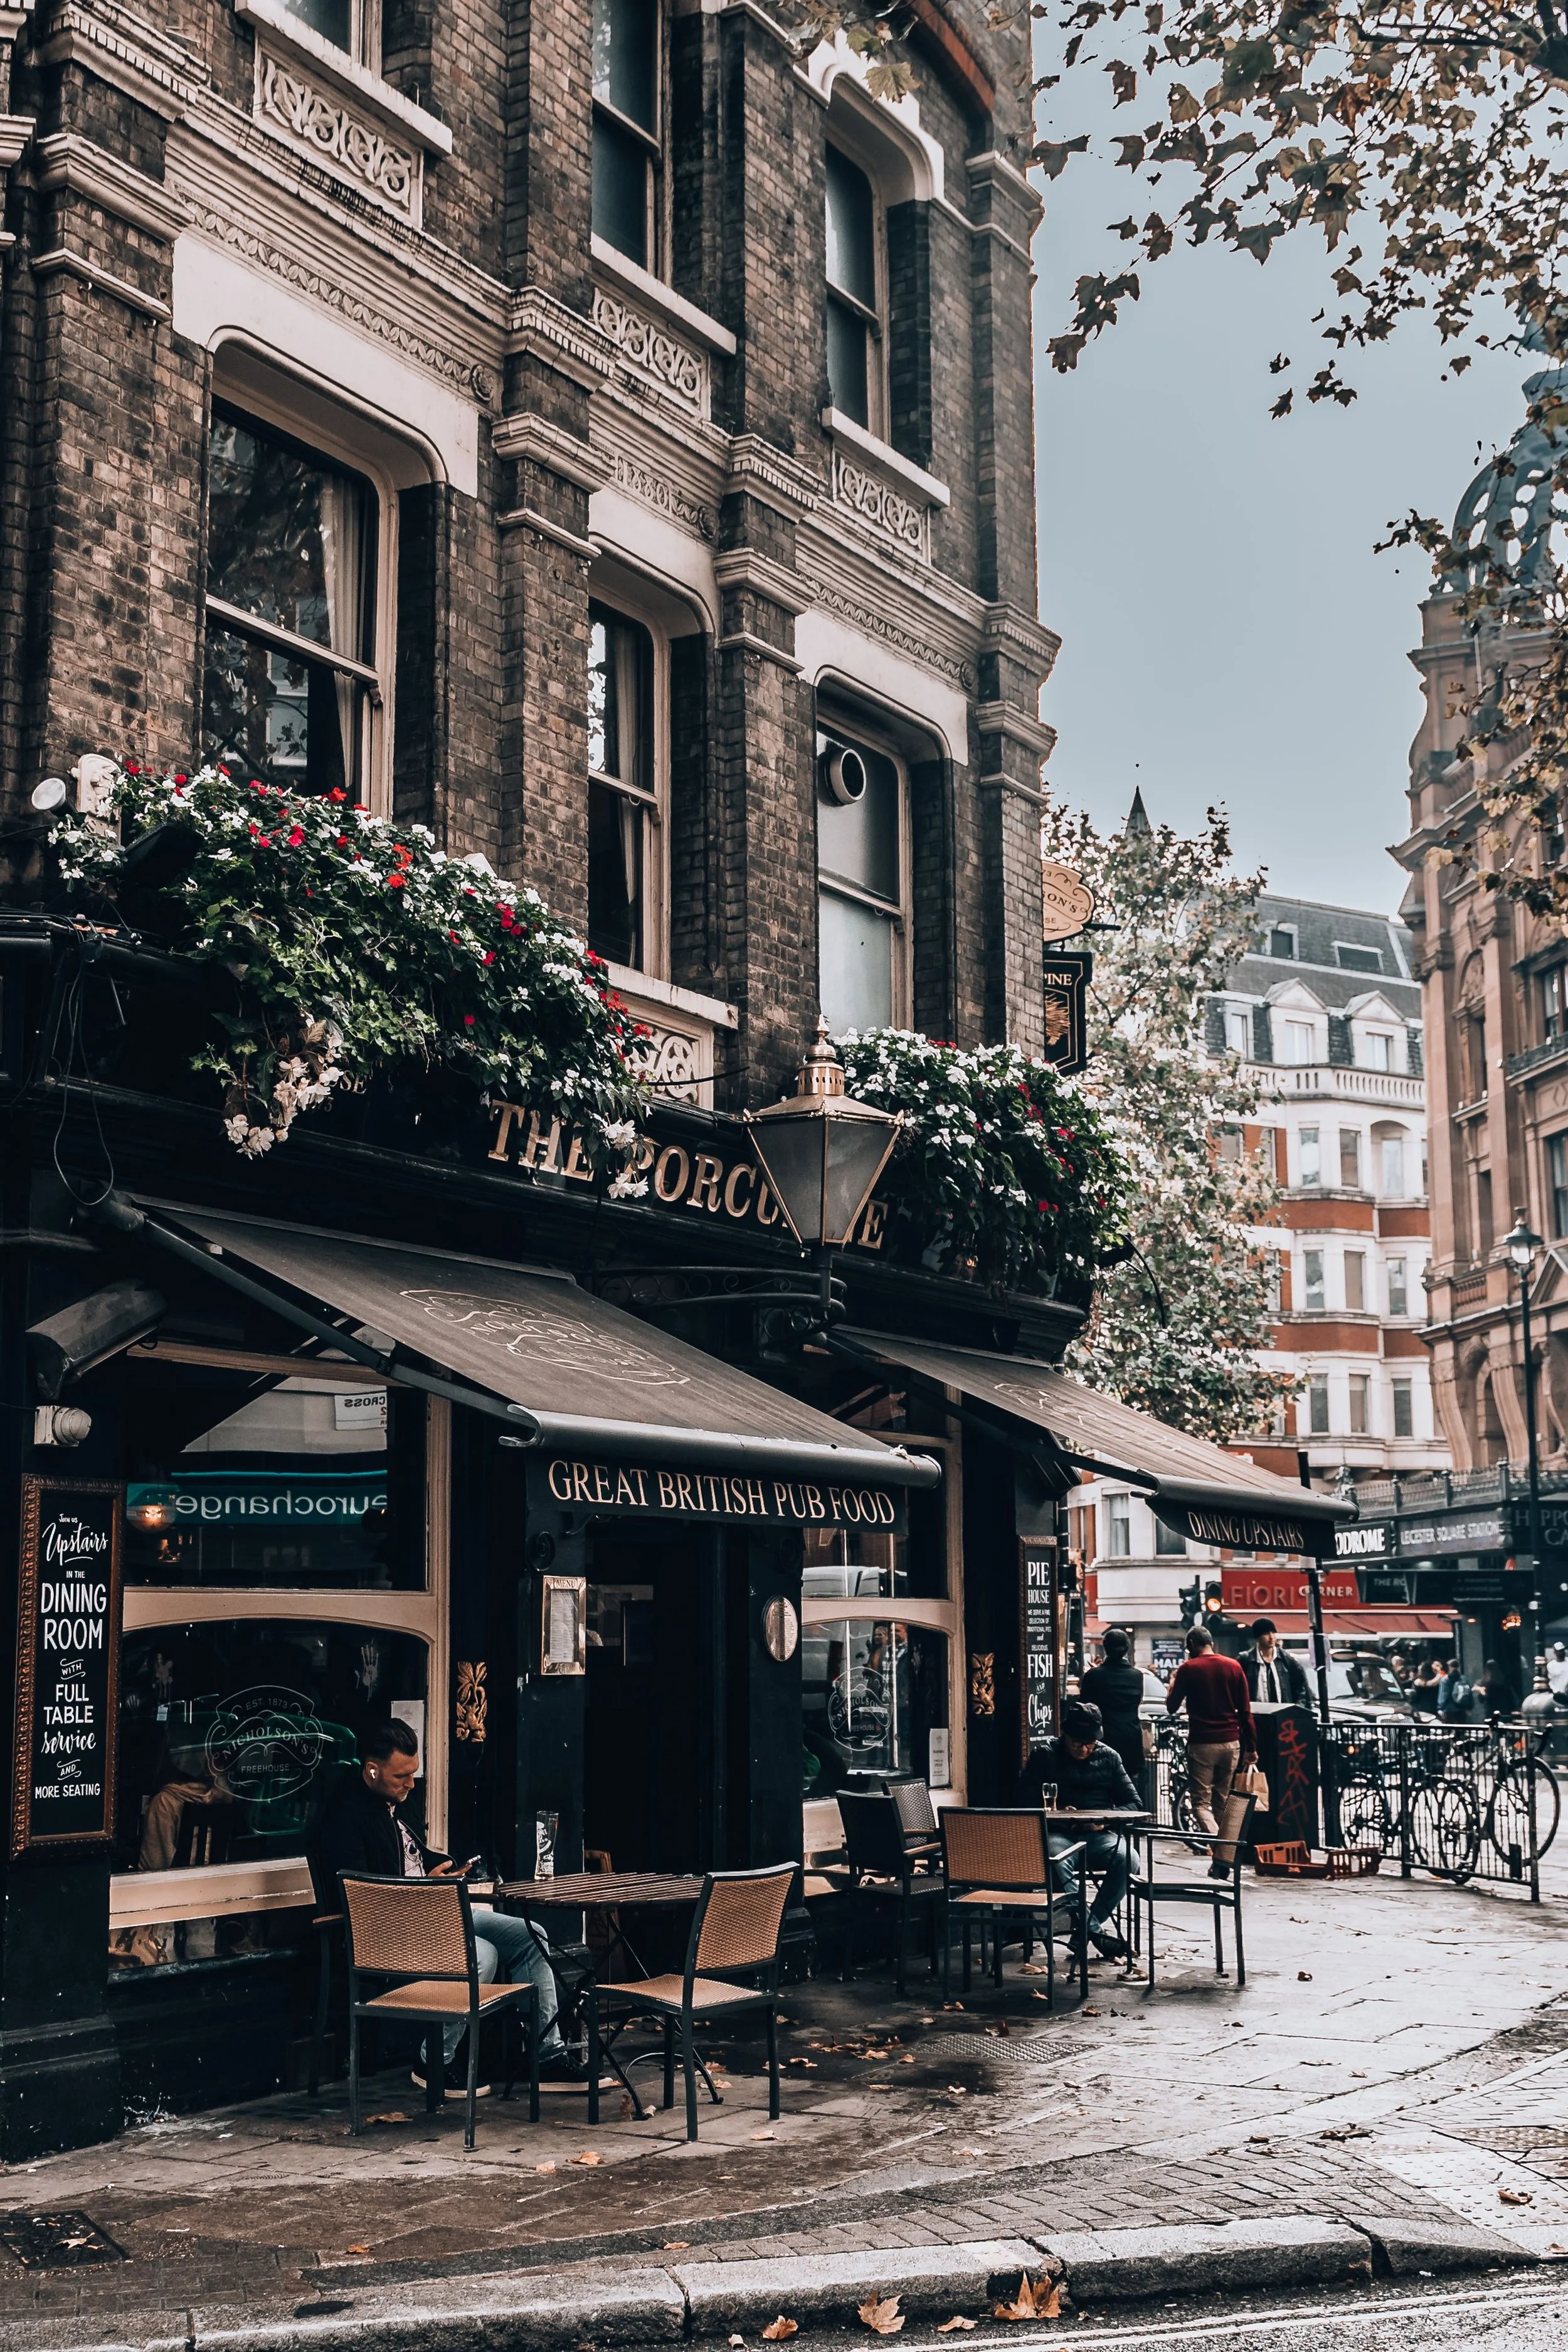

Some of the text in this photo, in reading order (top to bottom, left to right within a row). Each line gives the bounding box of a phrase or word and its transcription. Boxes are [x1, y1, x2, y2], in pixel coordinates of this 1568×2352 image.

[549, 1460, 895, 1523] GREAT BRITISH PUB FOOD
[1187, 1512, 1305, 1549] DINING UPSTAIRS
[42, 1522, 109, 1566] Upstairs
[74, 1571, 85, 1579] THE
[1027, 1562, 1050, 1586] PIE
[41, 1582, 107, 1613] DINING
[1027, 1589, 1050, 1604] HOUSE
[1231, 1585, 1295, 1606] FIORI
[44, 1618, 103, 1650] ROOM
[61, 1663, 82, 1676] WITH
[1027, 1654, 1053, 1678] FISH
[56, 1683, 89, 1702] FULL
[268, 1698, 287, 1709] 1873
[43, 1705, 94, 1725] TABLE
[1028, 1693, 1053, 1728] Chips
[41, 1730, 97, 1754] service
[221, 1726, 309, 1761] NICHOLSON'S
[60, 1764, 77, 1776] AND
[241, 1763, 290, 1774] FREEHOUSE
[35, 1783, 100, 1799] MORE SEATING
